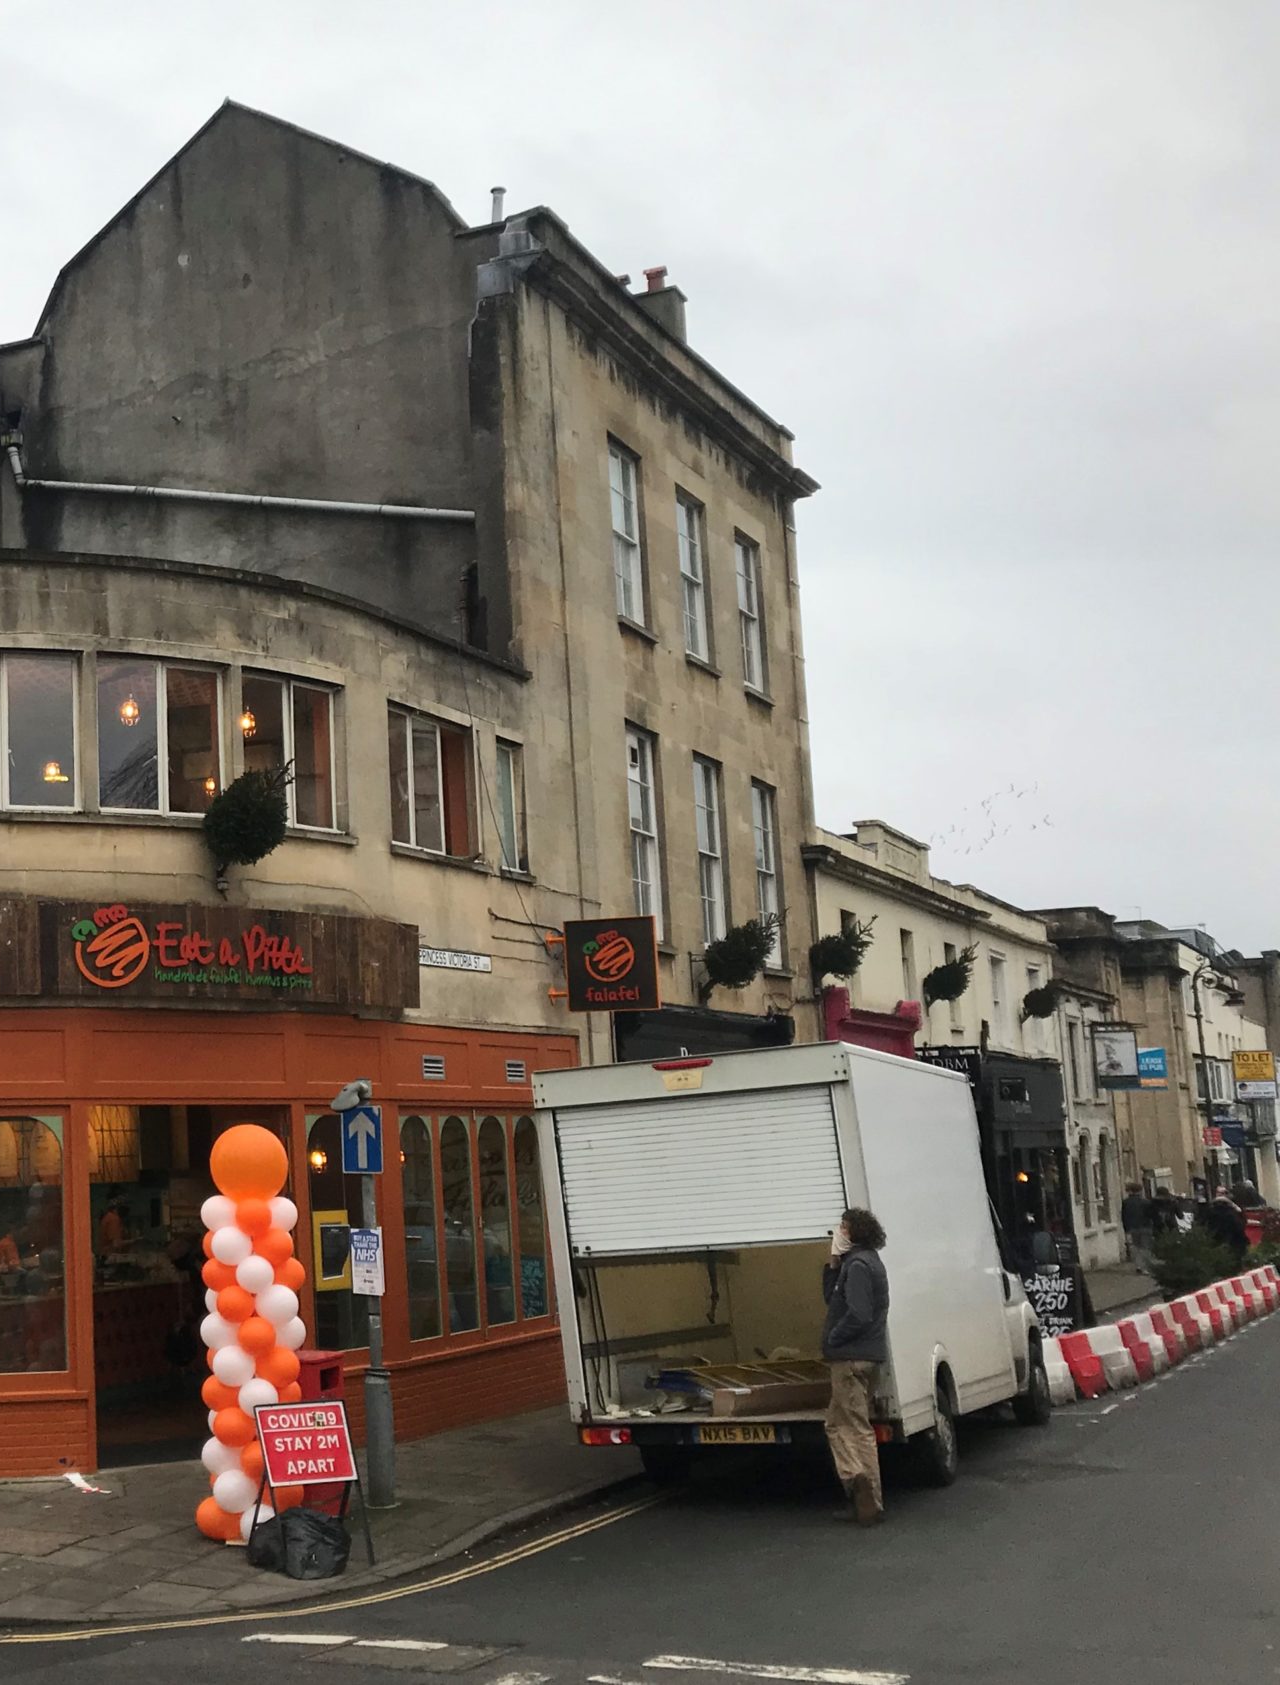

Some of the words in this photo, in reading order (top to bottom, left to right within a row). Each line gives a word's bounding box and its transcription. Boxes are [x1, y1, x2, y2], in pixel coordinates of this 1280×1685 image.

[153, 922, 215, 967] Eat
[219, 936, 241, 966] a
[242, 925, 313, 974] Pitta
[448, 954, 472, 967] VICTORIA
[154, 966, 208, 984] handmade
[209, 967, 242, 985] falafel
[245, 969, 281, 986] hummus
[586, 986, 640, 1001] falafel
[1236, 1053, 1249, 1062] TO
[1251, 1053, 1269, 1062] LET
[356, 1249, 376, 1261] NHS
[1024, 1277, 1074, 1292] SARNIE
[1034, 1292, 1068, 1312] 250
[702, 1427, 736, 1441] NX15
[742, 1427, 770, 1441] BAV
[274, 1436, 313, 1452] STAY
[317, 1434, 340, 1449] 2M
[287, 1458, 336, 1475] APART
